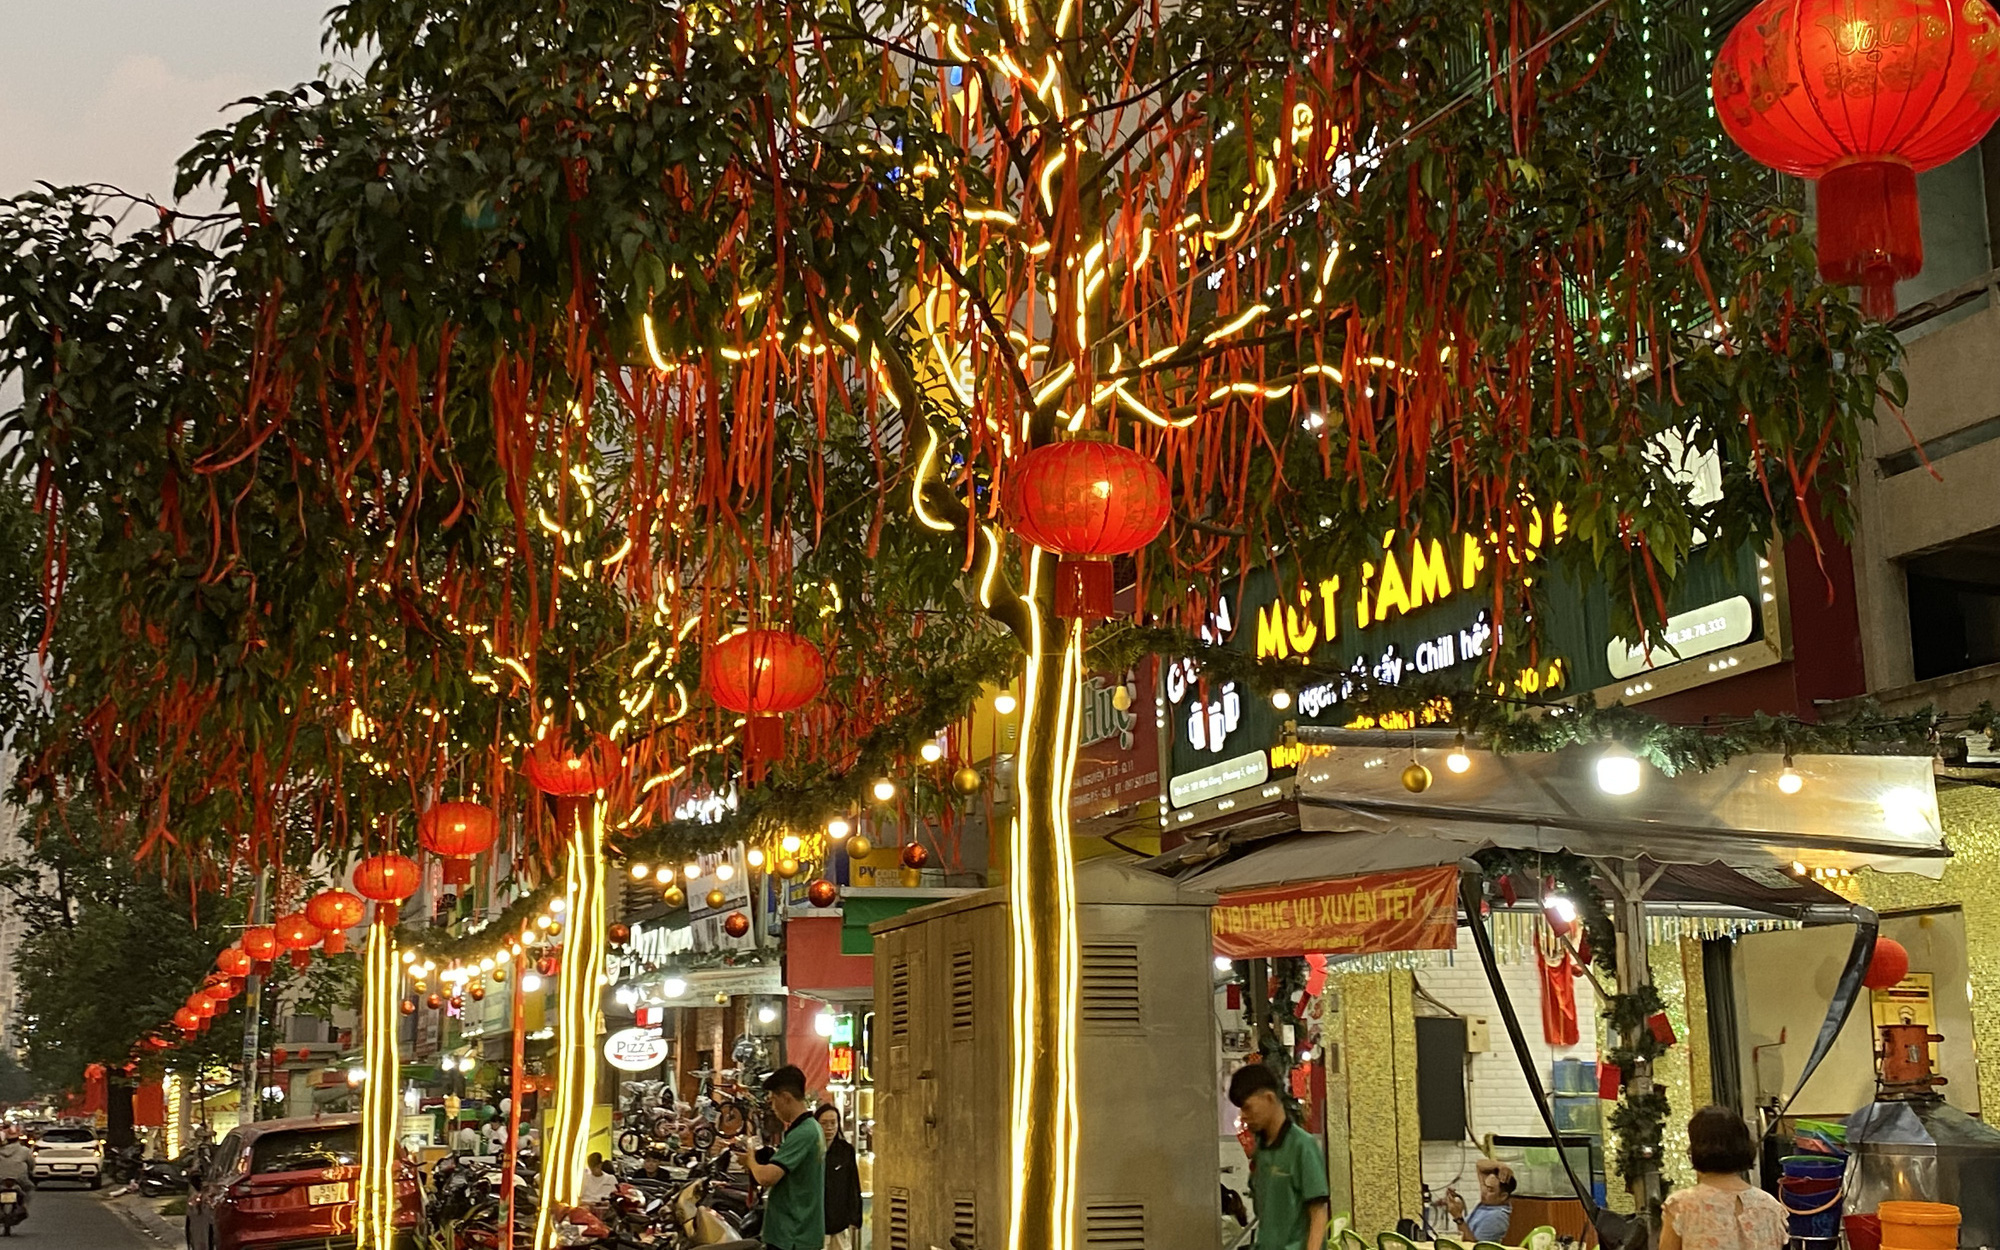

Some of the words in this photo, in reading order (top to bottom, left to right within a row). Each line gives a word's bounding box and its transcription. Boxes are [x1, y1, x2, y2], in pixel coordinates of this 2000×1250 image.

[1416, 634, 1455, 674] Chill
[1293, 896, 1315, 934] VỤ
[1319, 885, 1378, 925] XUYÊN
[1381, 879, 1417, 921] TẾT
